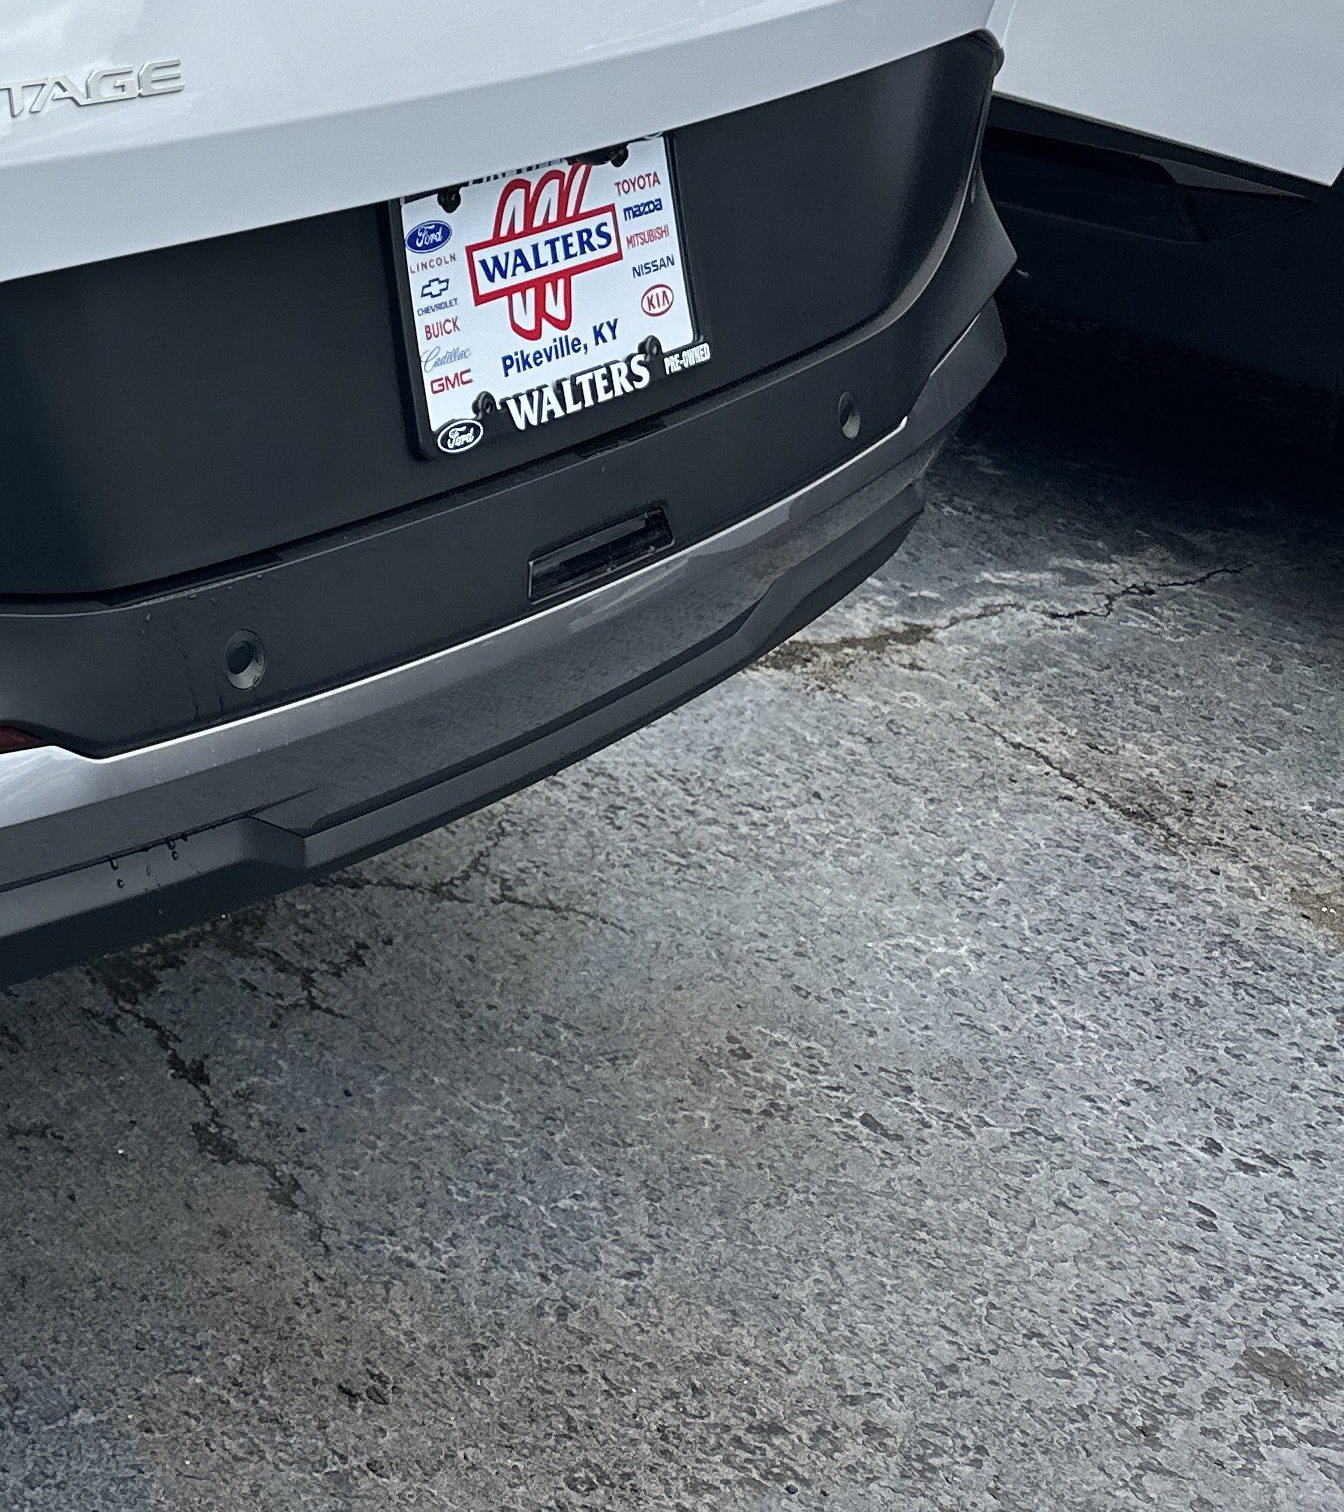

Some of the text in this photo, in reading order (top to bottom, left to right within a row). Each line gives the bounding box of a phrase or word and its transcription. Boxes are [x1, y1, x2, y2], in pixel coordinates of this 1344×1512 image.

[614, 171, 661, 196] TOYOTA
[626, 224, 670, 249] MITSUBISHI
[409, 252, 457, 274] LINCOLN
[478, 222, 612, 283] WALTERS
[632, 254, 675, 279] NISSAN
[417, 297, 458, 316] CHEVROLET
[646, 290, 670, 312] KIA
[424, 316, 460, 340] BUICK
[421, 345, 472, 374] Cadillac
[501, 318, 620, 378] Pikeville, KY
[430, 368, 473, 395] GMC
[507, 355, 651, 431] WALTERS
